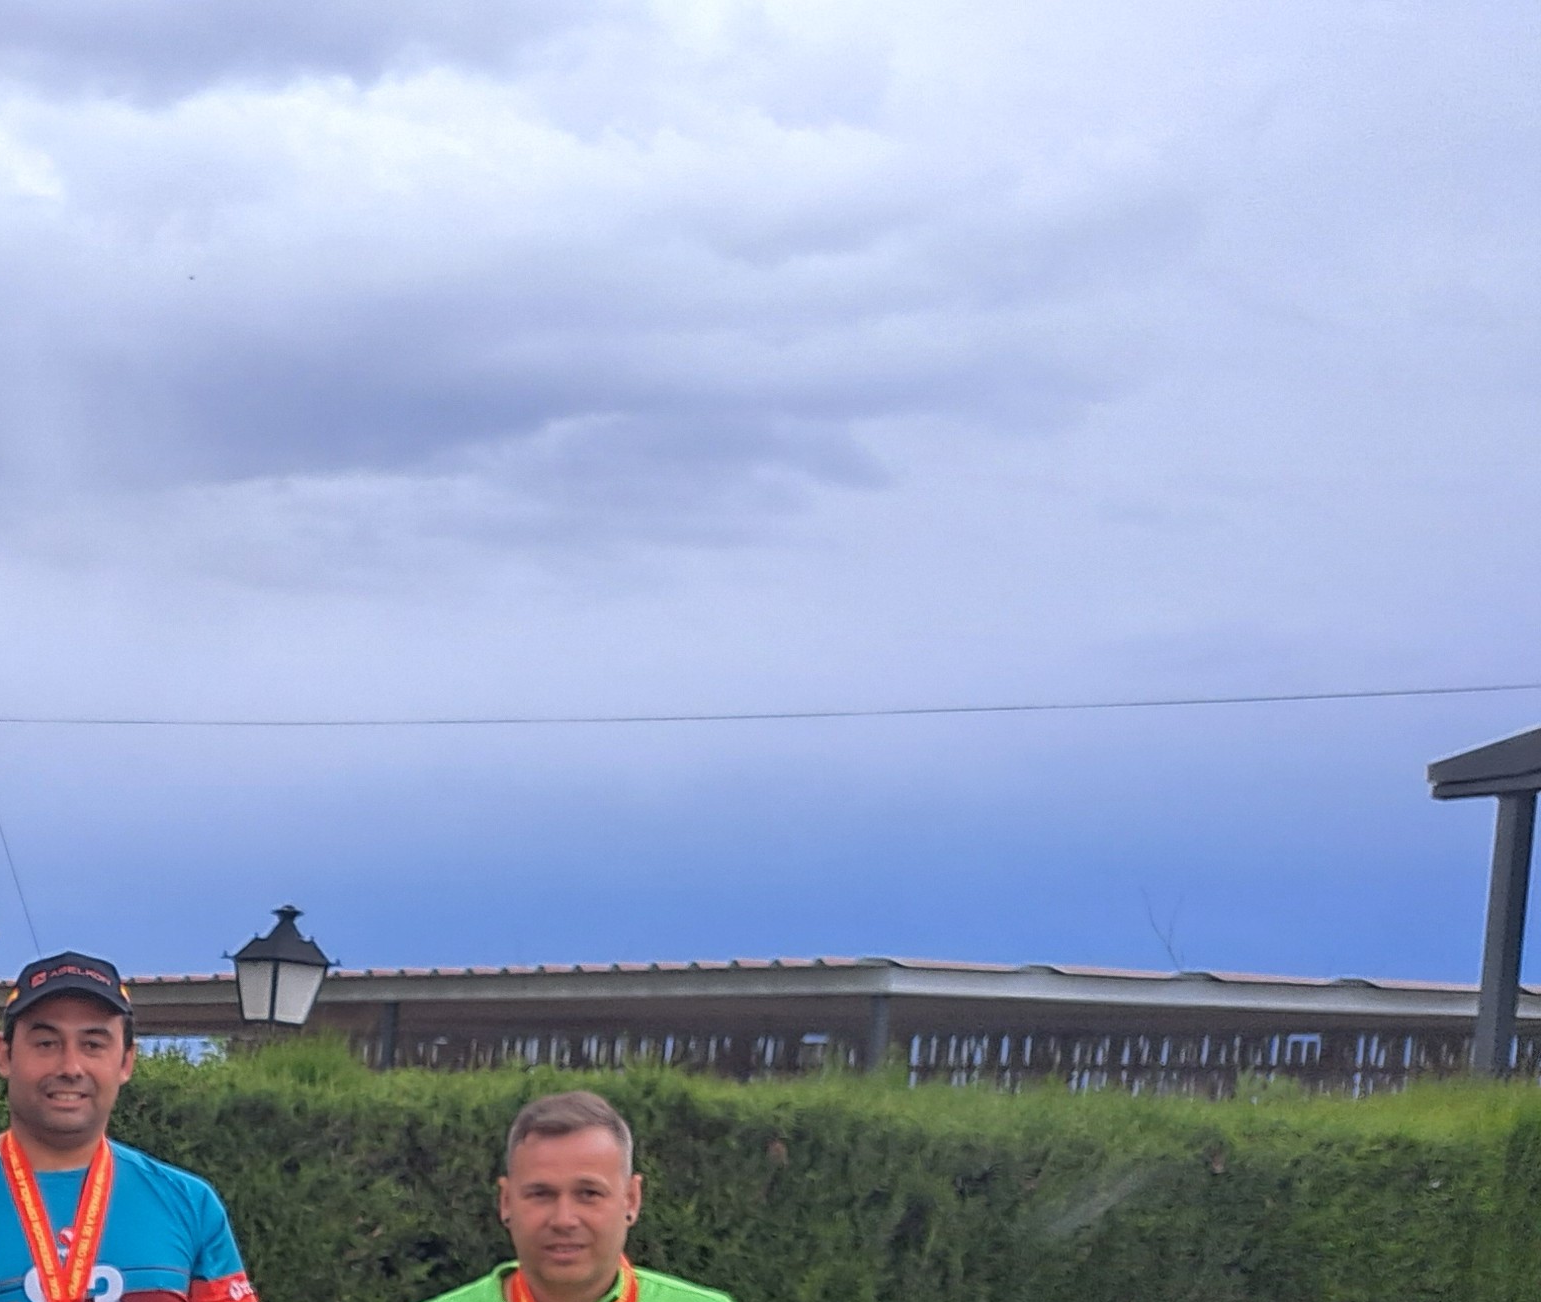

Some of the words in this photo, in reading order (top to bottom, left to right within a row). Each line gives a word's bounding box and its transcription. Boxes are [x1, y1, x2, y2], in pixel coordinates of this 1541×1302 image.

[19, 1181, 39, 1221] ESPAÑOLA
[85, 1185, 102, 1225] ESPAÑOLA
[82, 1225, 93, 1237] DE
[32, 1221, 54, 1275] FEDERACIÓN
[77, 1238, 90, 1257] TIRO
[49, 1276, 61, 1300] REAL
